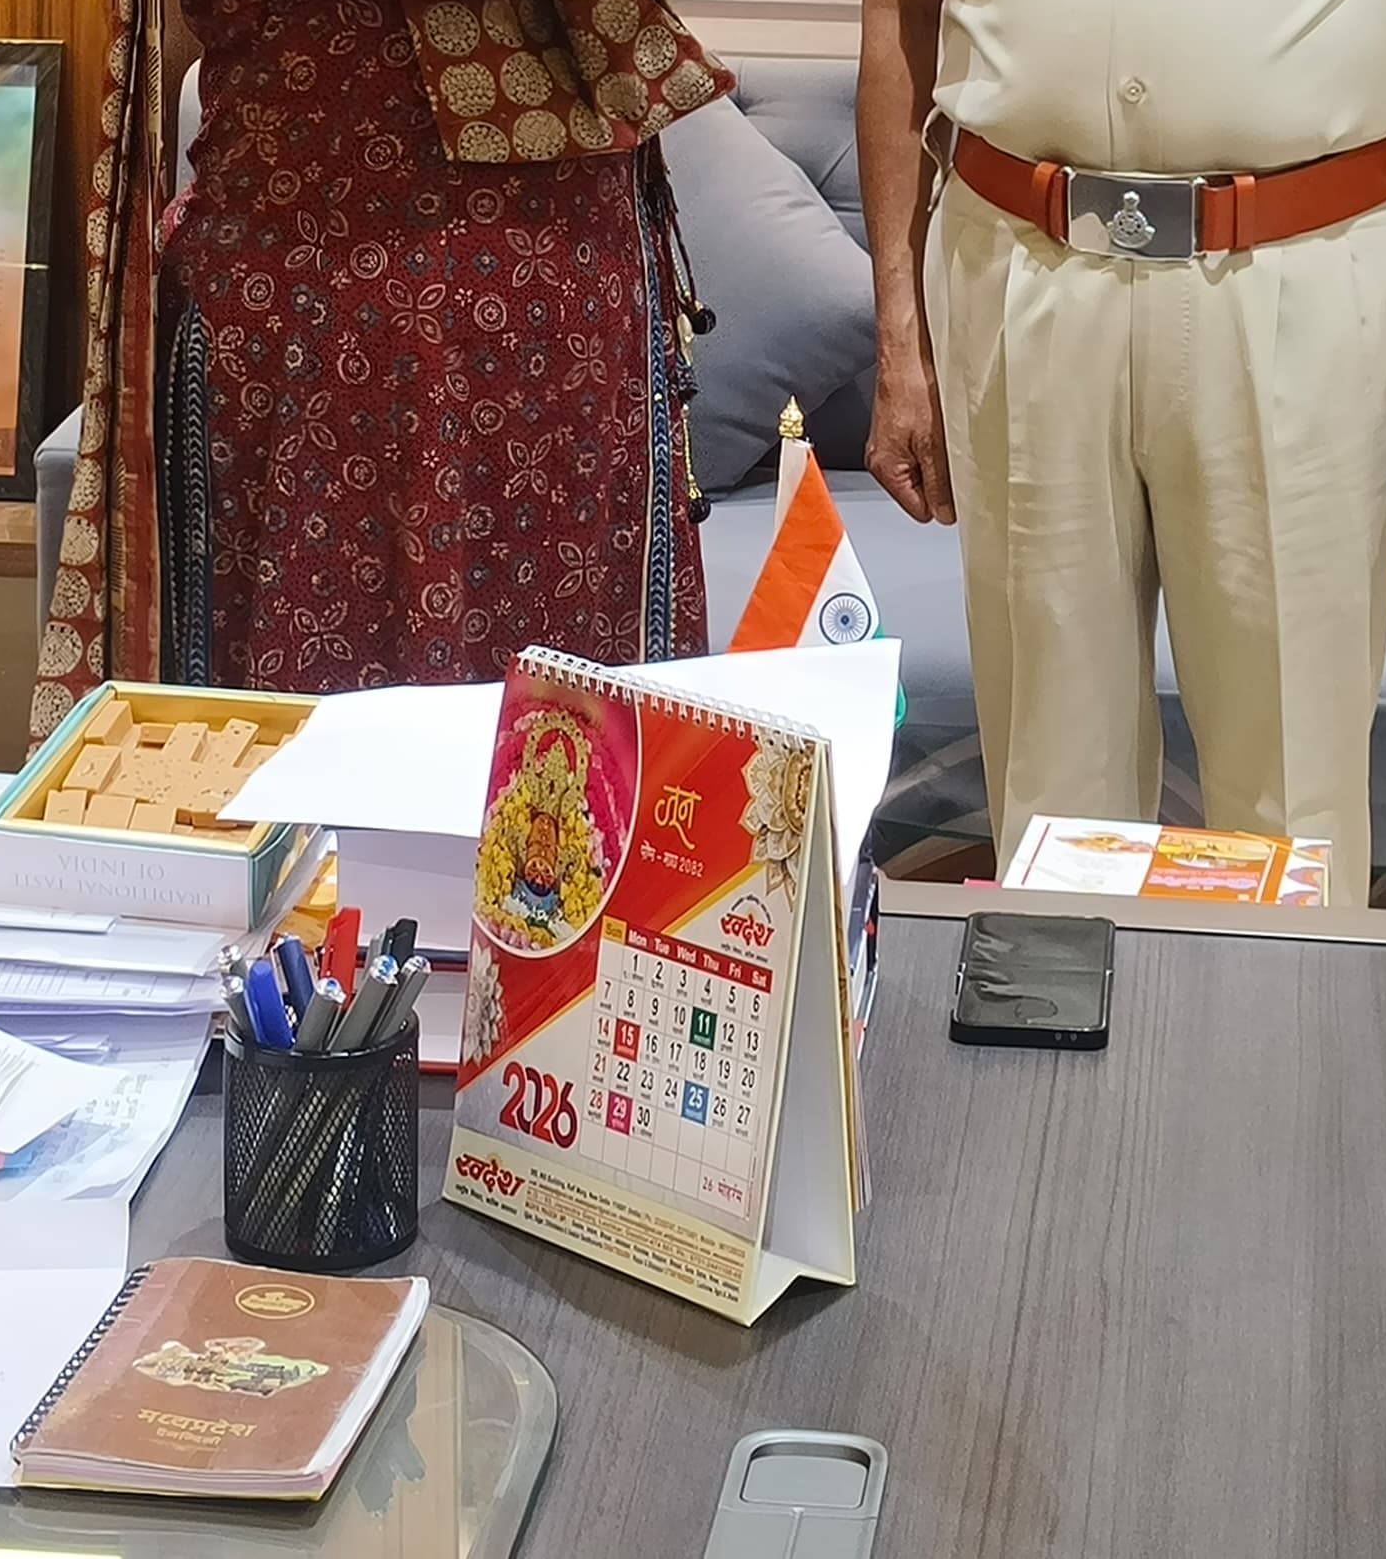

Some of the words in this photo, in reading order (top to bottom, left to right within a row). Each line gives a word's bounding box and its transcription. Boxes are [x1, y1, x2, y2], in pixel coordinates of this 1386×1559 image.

[653, 784, 702, 851] जून
[58, 853, 126, 877] INDIA
[628, 929, 647, 948] Mon
[654, 937, 670, 955] Tue
[676, 945, 697, 964] Wed
[702, 954, 720, 972] Thu
[728, 962, 742, 979] Fri
[751, 970, 768, 988] Sat
[719, 912, 775, 948] स्वदेश
[632, 953, 639, 972] 1
[655, 960, 664, 980] 2
[679, 969, 687, 988] 3
[703, 978, 712, 996] 4
[728, 986, 736, 1005] 5
[752, 993, 761, 1013] 6
[604, 980, 612, 1000] 7
[626, 989, 635, 1009] 8
[651, 997, 659, 1017] 9
[673, 1005, 687, 1026] 10
[697, 1013, 710, 1034] 11
[722, 1022, 735, 1044] 12
[746, 1030, 759, 1052] 13
[597, 1017, 609, 1037] 14
[620, 1024, 635, 1047] 15
[645, 1033, 658, 1054] 16
[669, 1041, 683, 1062] 17
[693, 1050, 706, 1072] 18
[718, 1058, 731, 1080] 19
[741, 1067, 755, 1089] 20
[498, 1060, 579, 1150] 2026
[589, 1089, 603, 1110] 28
[612, 1097, 627, 1120] 29
[636, 1105, 651, 1127] 30
[593, 1052, 606, 1074] 21
[616, 1061, 630, 1083] 22
[640, 1069, 654, 1091] 23
[664, 1077, 678, 1100] 24
[688, 1086, 703, 1109] 25
[713, 1095, 727, 1118] 26
[737, 1104, 751, 1126] 27
[454, 1152, 526, 1197] स्वदेश
[137, 1408, 258, 1437] मध्यप्रदेश
